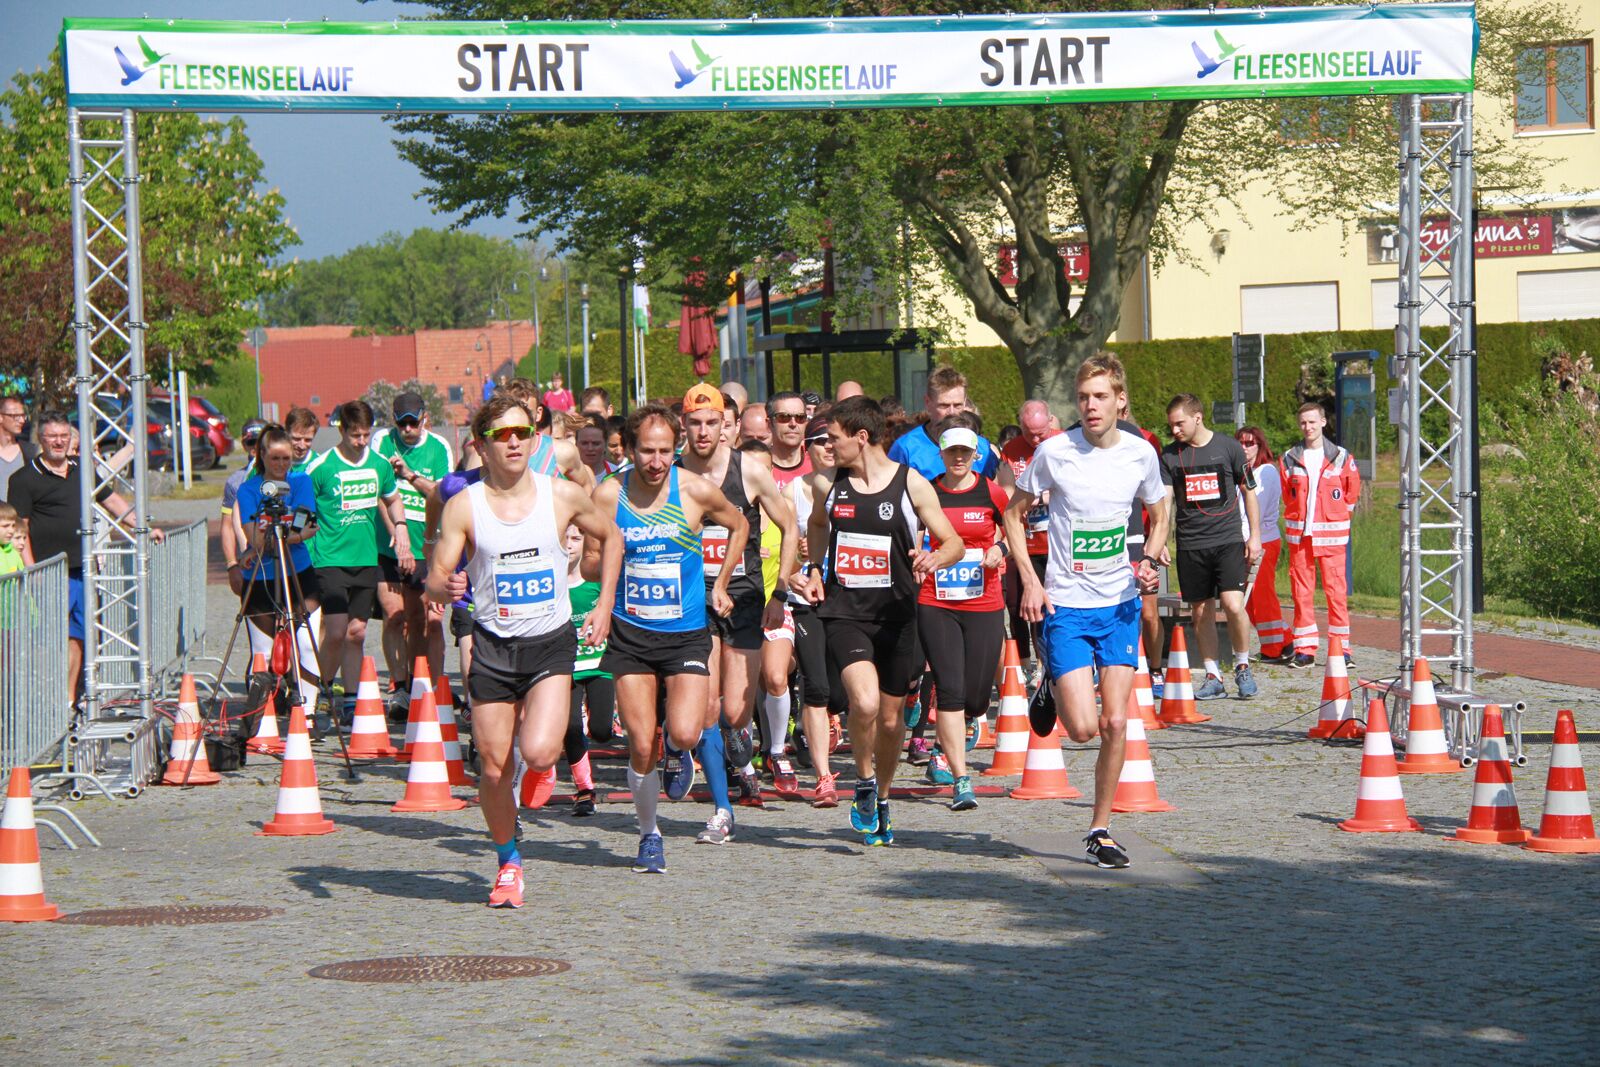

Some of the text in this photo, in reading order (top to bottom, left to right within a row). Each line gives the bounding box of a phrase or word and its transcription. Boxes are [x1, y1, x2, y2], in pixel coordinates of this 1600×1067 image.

[457, 42, 590, 92] START
[980, 36, 1110, 86] START
[1233, 50, 1422, 80] FLEESENSEELAUF
[158, 63, 354, 93] FLEESENSEELAUF
[711, 64, 898, 92] FLEESENSEELAUF
[1490, 242, 1541, 253] Pizzeria
[343, 482, 377, 497] 2228
[1186, 480, 1219, 492] 2168
[636, 544, 666, 553] avacon
[1074, 532, 1124, 553] 2227
[838, 552, 888, 569] 2165
[937, 567, 981, 582] 2196
[497, 577, 554, 598] 2183
[627, 582, 677, 600] 2191
